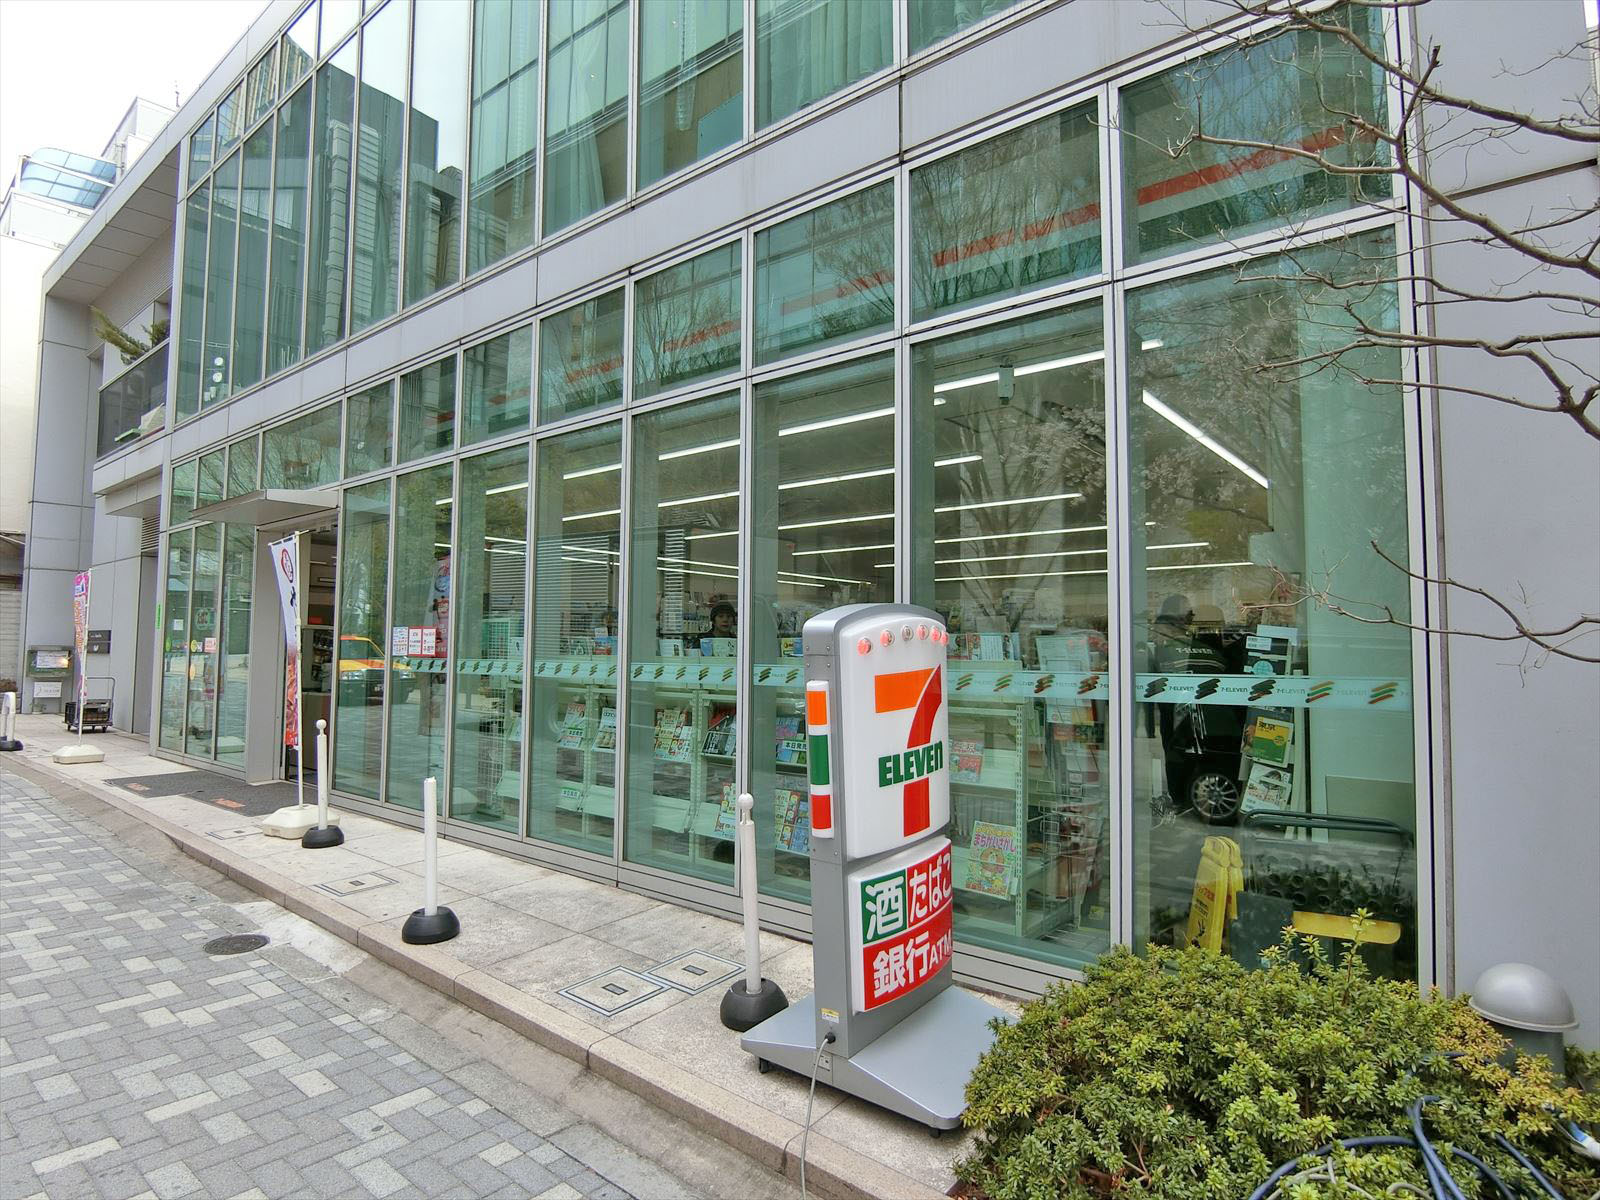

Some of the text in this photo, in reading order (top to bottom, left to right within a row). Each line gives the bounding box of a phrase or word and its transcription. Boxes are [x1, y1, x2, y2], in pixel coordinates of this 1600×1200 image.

[1168, 685, 1195, 693] 7-ELEVEN
[1220, 686, 1249, 694] 7-ELEVEN
[1276, 687, 1306, 695] 7-ELEVEN
[878, 741, 944, 788] ELEVEN
[865, 875, 904, 940] 酒
[909, 854, 952, 923] たばこ
